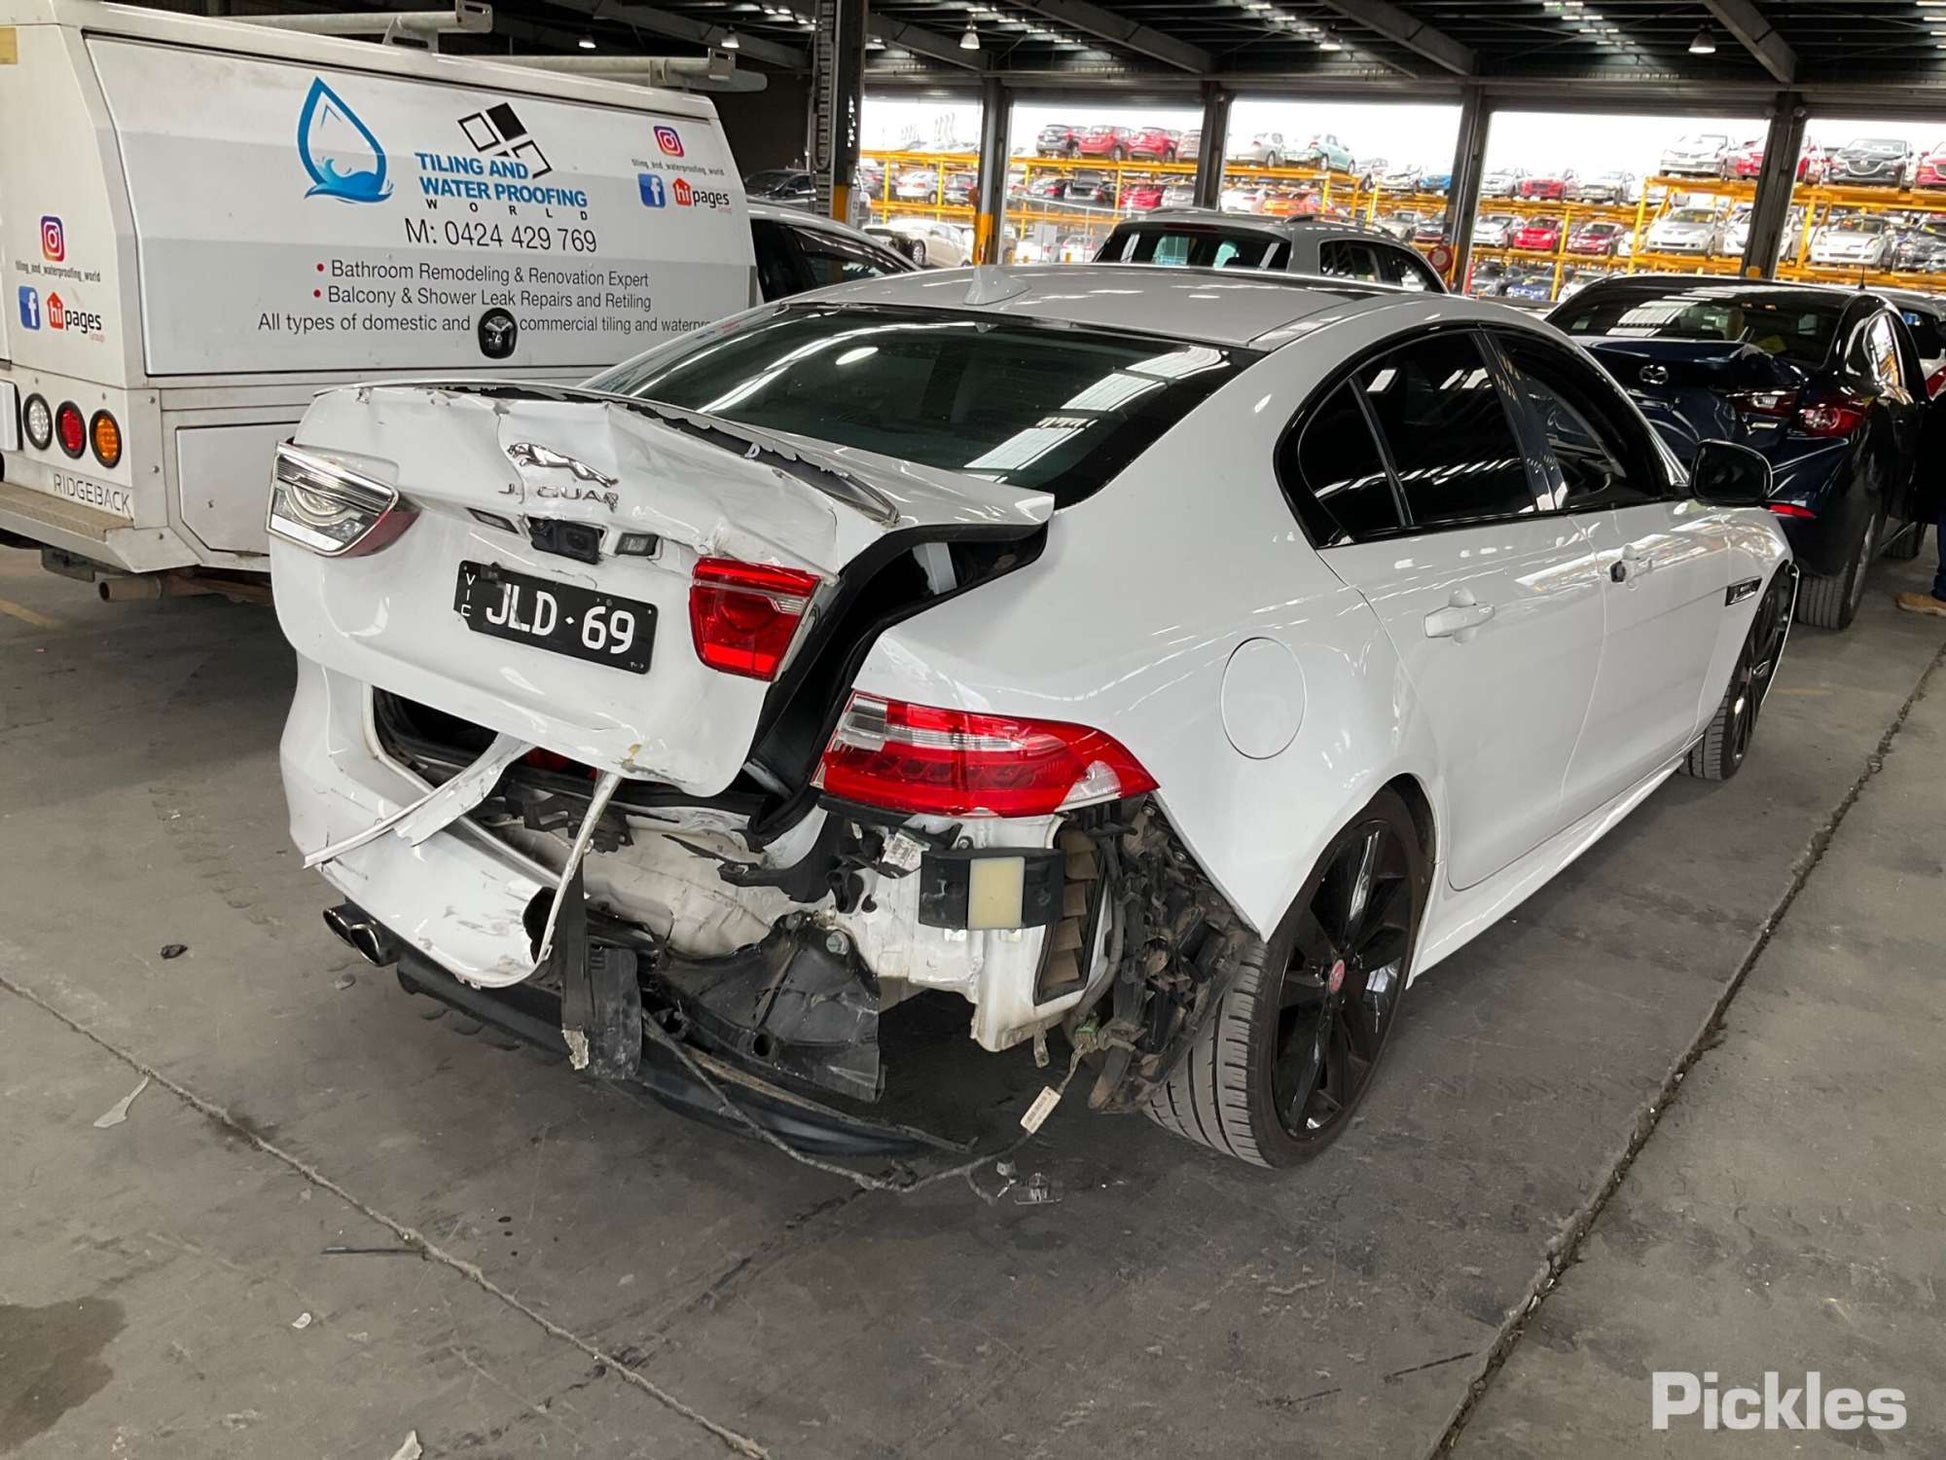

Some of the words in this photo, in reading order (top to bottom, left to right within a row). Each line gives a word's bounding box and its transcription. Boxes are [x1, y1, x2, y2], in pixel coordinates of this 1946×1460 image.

[414, 152, 484, 175] TILING
[488, 160, 529, 179] AND
[419, 176, 491, 200] WATER
[494, 184, 588, 208] PROOFING
[404, 217, 437, 244] M:
[444, 220, 503, 247] 0424
[511, 225, 551, 250] 429
[557, 227, 597, 253] 769
[331, 259, 414, 279] Bathroom
[419, 263, 510, 286] Remodeling
[514, 269, 524, 283] &
[529, 267, 604, 286] Renovation
[608, 271, 649, 290] Expert
[328, 285, 396, 308] Balcony
[401, 287, 412, 304] &
[417, 287, 477, 305] Shower
[481, 289, 516, 306] Leak
[521, 290, 573, 310] Repairs
[577, 294, 601, 308] and
[605, 293, 652, 312] Retiling
[258, 313, 280, 331] All
[286, 314, 335, 334] types
[340, 314, 357, 331] of
[362, 314, 437, 331] domestic
[442, 315, 470, 331] and
[519, 316, 598, 332] commercial
[602, 316, 631, 334] tiling
[635, 318, 658, 332] and
[661, 318, 711, 332] waterpr
[53, 473, 132, 513] RIDGEBACK
[461, 572, 476, 617] VIC
[485, 582, 558, 636] JLD
[581, 605, 635, 654] 69
